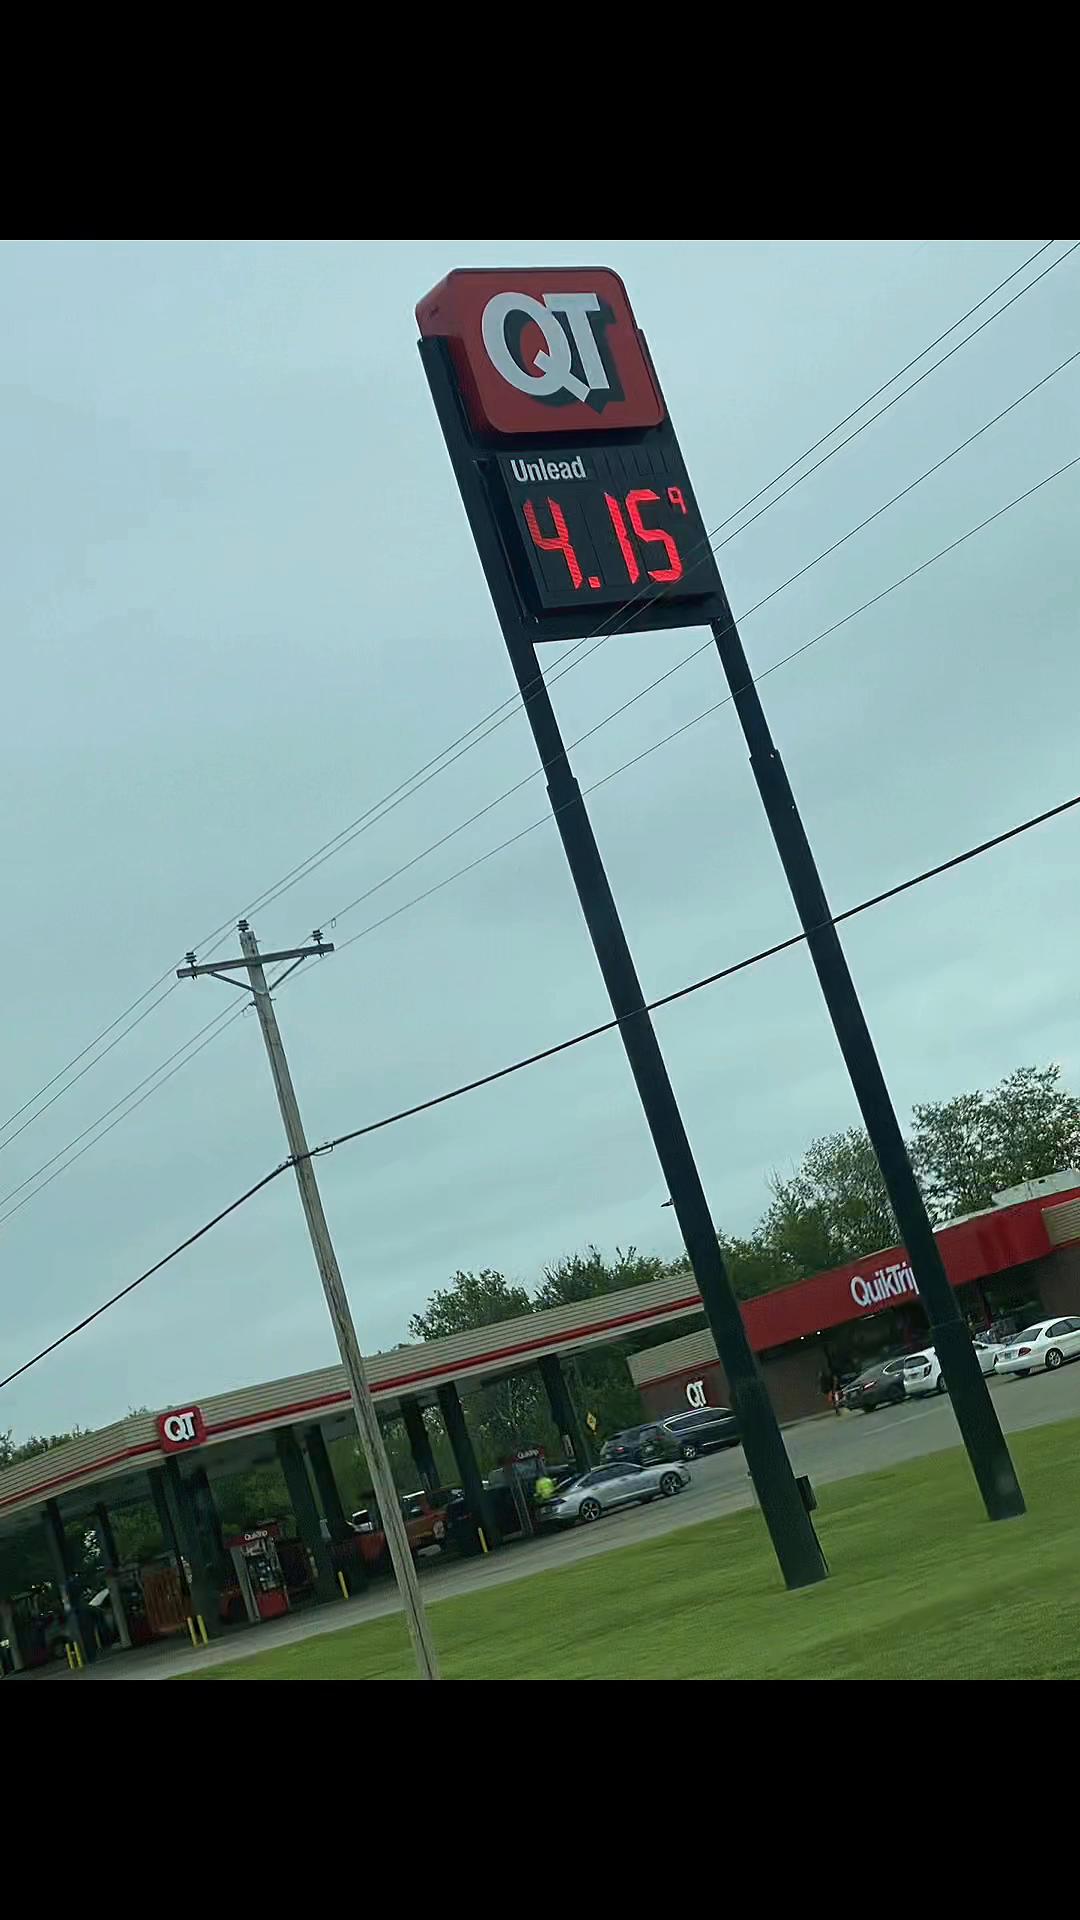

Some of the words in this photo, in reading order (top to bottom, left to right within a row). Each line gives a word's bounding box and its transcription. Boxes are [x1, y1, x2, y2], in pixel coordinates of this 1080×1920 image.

[481, 292, 610, 402] QT
[510, 456, 587, 482] Unlead
[686, 1380, 707, 1408] QT
[164, 1412, 195, 1442] QT
